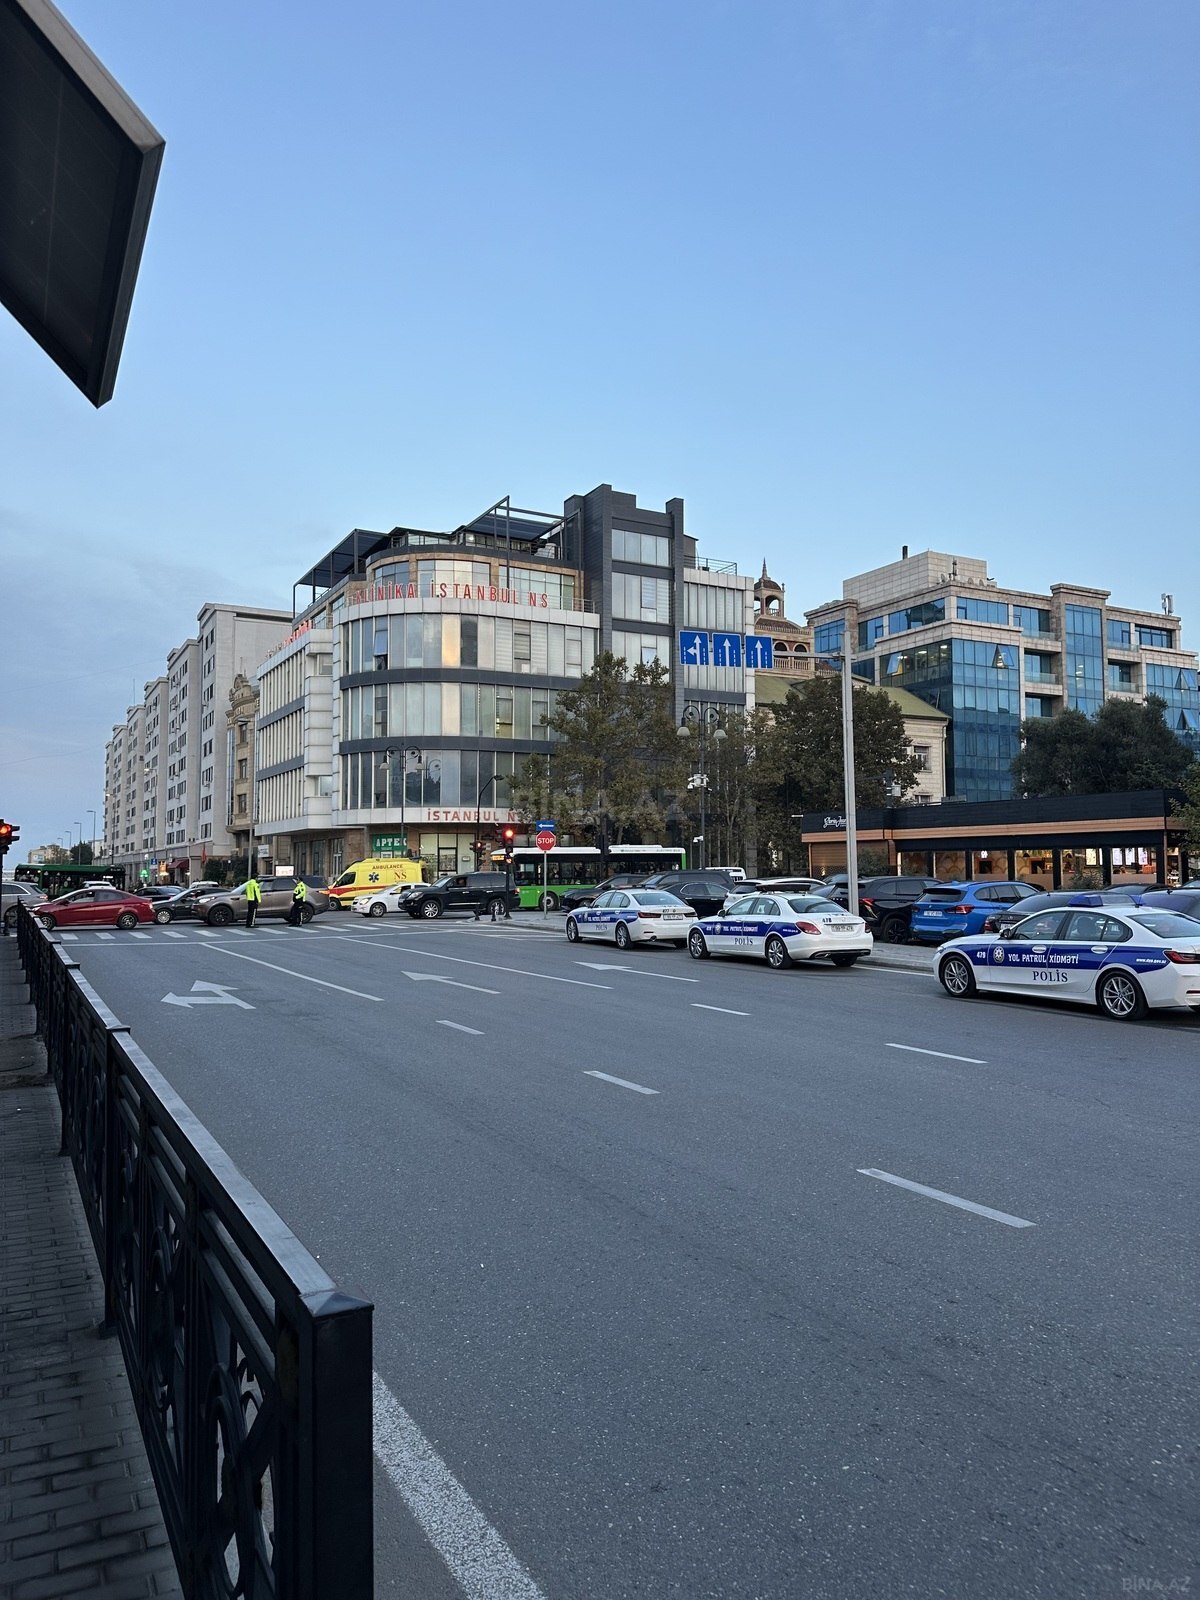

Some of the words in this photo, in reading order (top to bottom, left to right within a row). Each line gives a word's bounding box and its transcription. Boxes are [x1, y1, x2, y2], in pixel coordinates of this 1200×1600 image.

[431, 579, 518, 604] İSTANBUL
[529, 592, 548, 608] NS
[537, 837, 555, 845] STOP
[735, 936, 753, 946] POLİS
[1008, 953, 1020, 962] YOL
[1022, 954, 1047, 963] PATRUL
[1032, 969, 1068, 983] POLİS
